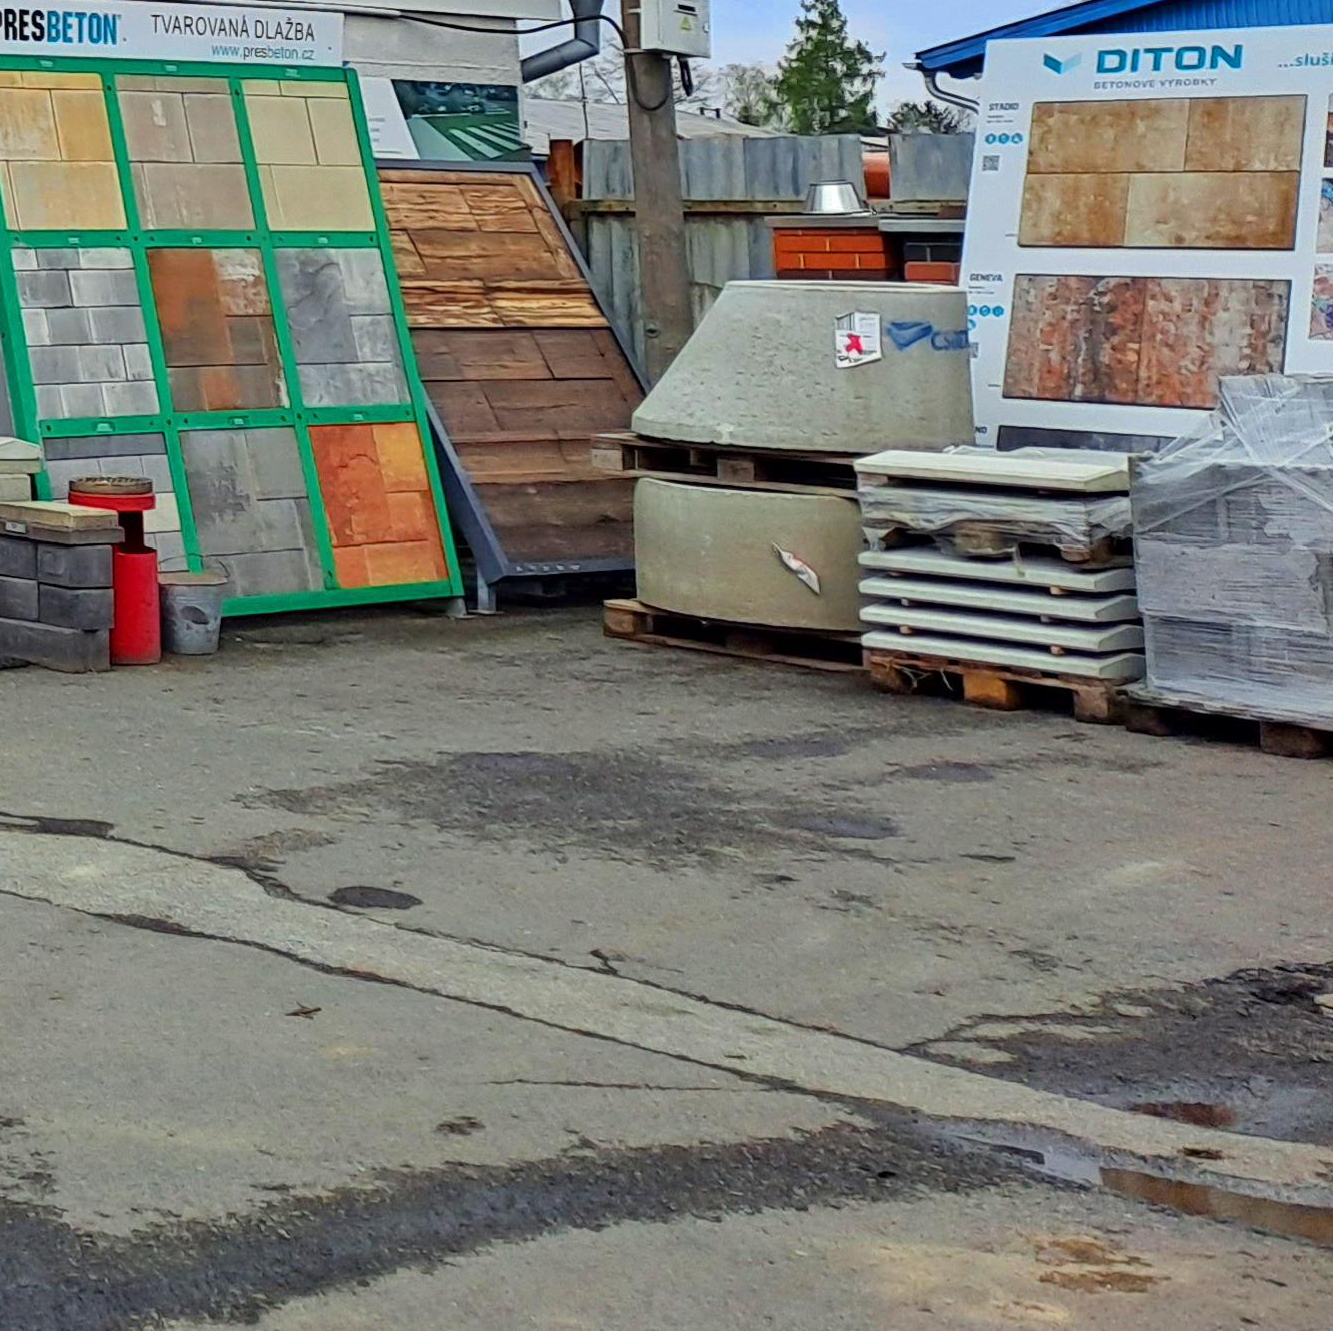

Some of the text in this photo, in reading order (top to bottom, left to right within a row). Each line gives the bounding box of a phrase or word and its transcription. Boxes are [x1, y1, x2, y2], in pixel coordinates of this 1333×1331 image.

[151, 14, 315, 42] TVAROVANÁ DLAŽBA
[211, 44, 315, 61] www.presbeton.cz
[1096, 45, 1244, 74] DITON
